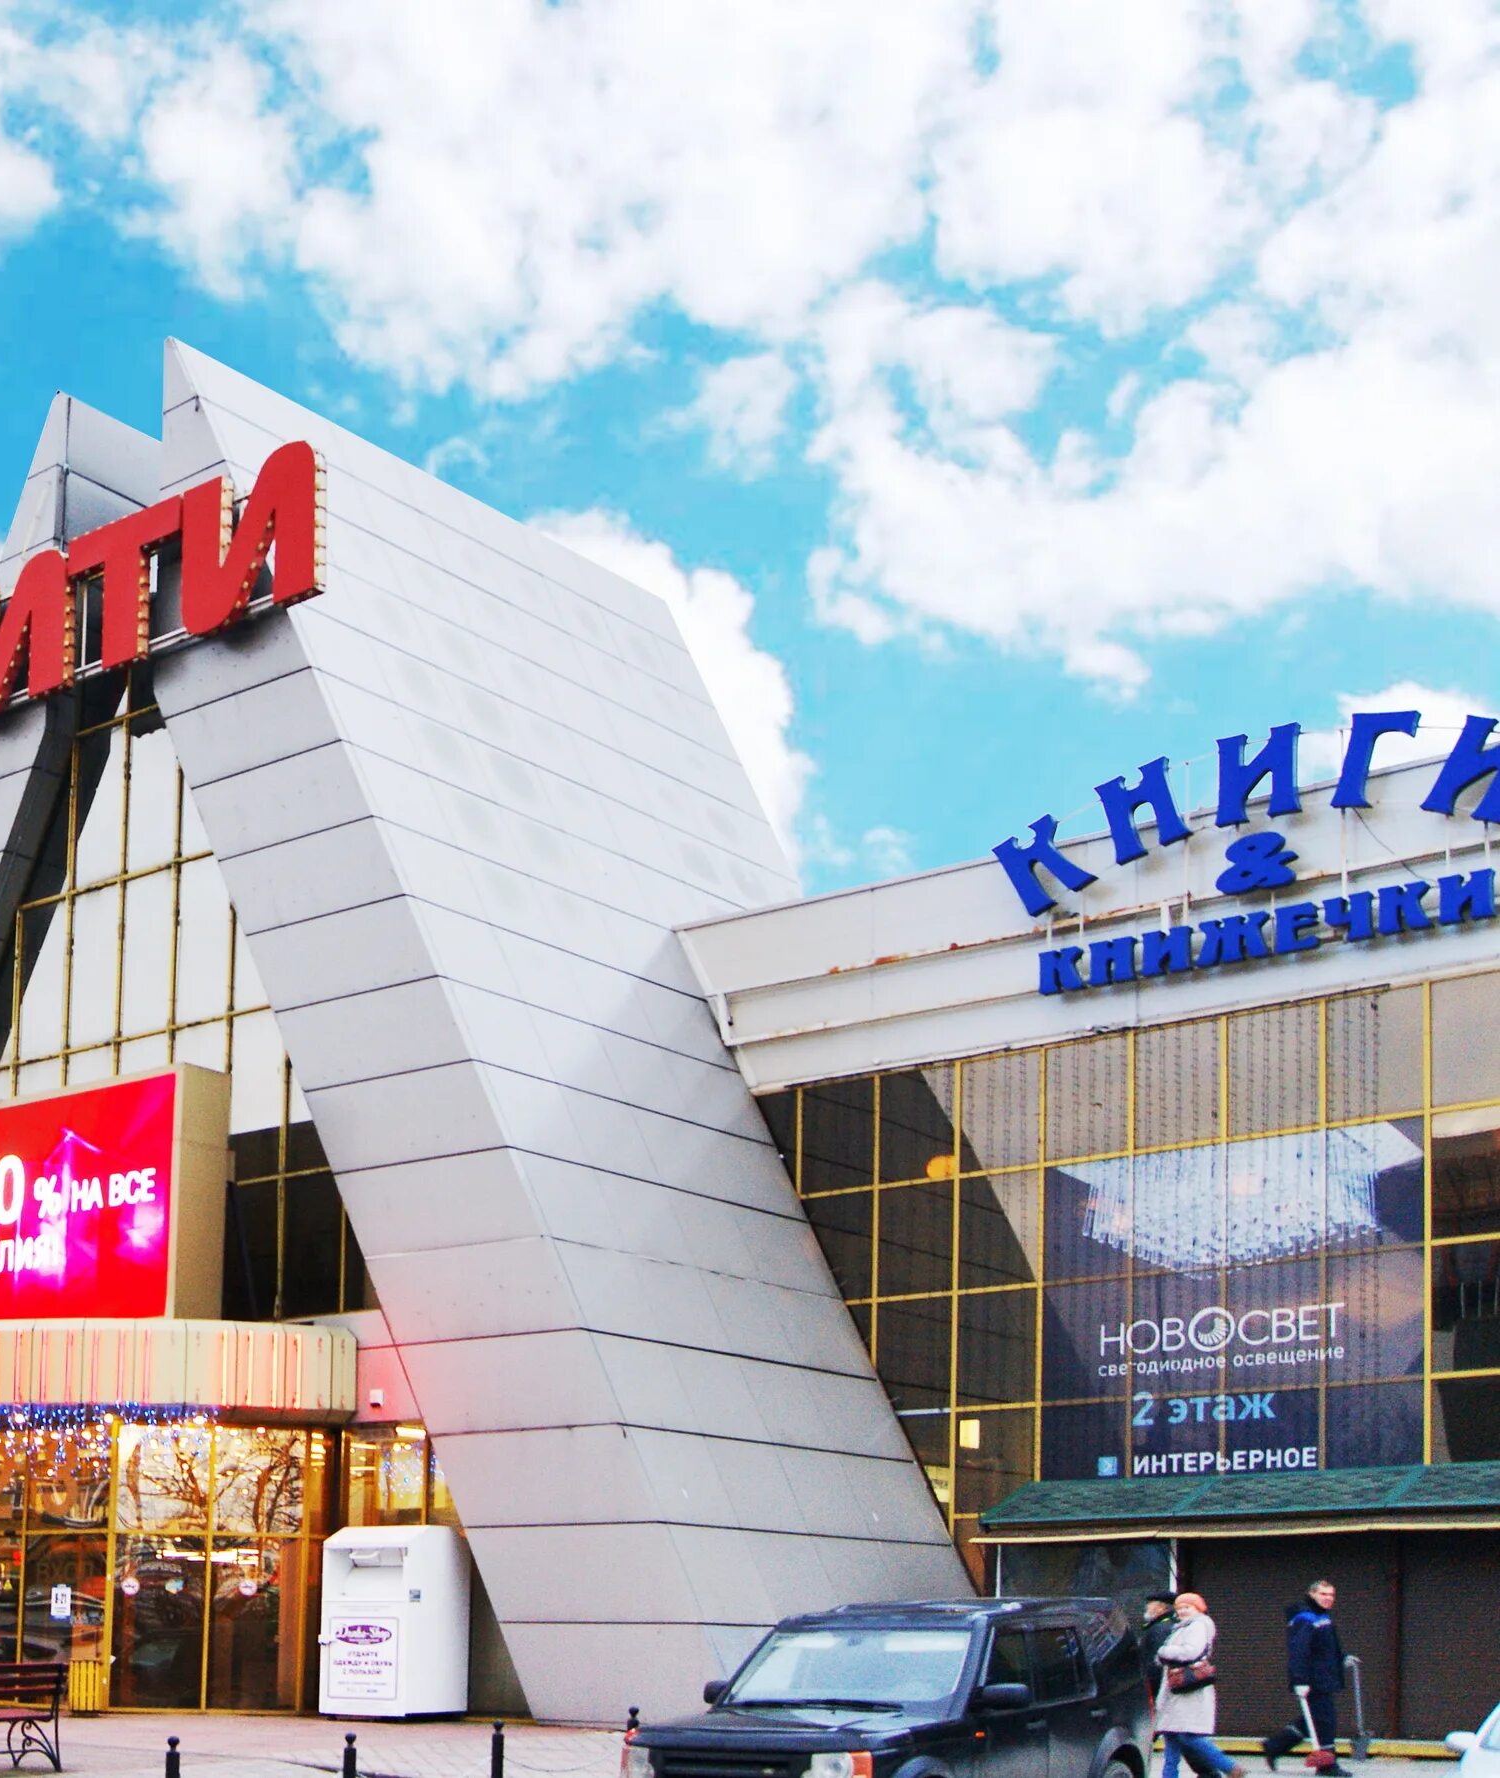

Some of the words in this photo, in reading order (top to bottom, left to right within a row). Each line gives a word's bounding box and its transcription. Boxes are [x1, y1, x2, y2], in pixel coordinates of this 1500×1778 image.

[991, 710, 1500, 918] КНИГИ
[1215, 831, 1300, 896] &
[1038, 868, 1497, 996] КНИЖЕЧКИ
[33, 1176, 61, 1219] %
[71, 1177, 104, 1213] НА
[108, 1167, 156, 1207] ВСЕ
[1100, 1302, 1345, 1357] НОВОСВЕТ
[1233, 1346, 1345, 1368] освещение
[1131, 1391, 1155, 1427] 2
[1167, 1391, 1277, 1424] этаж
[1133, 1446, 1318, 1475] ИНТЕРЬЕРНОЕ
